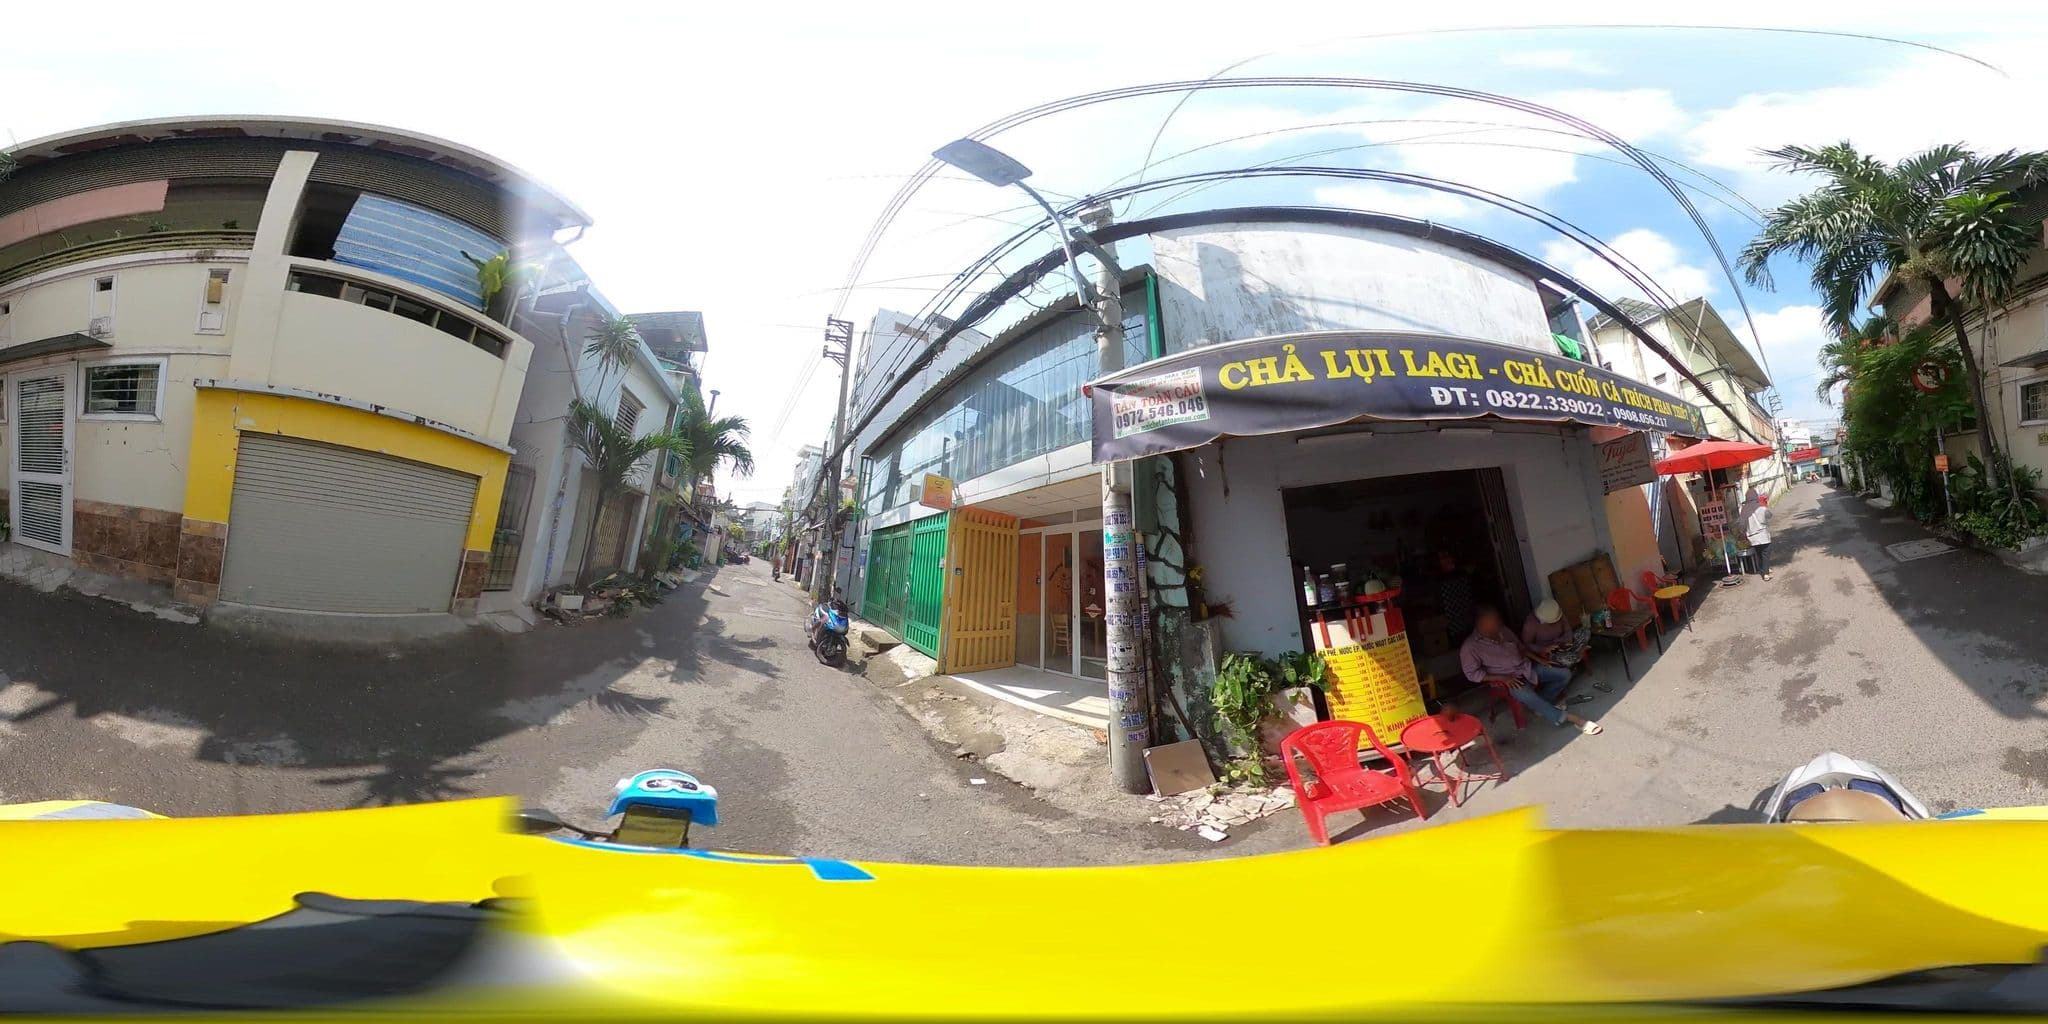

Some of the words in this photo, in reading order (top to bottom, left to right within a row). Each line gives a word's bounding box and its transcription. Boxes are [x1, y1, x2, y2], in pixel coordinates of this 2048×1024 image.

[1218, 343, 1315, 391] CHẢ
[1320, 348, 1396, 385] LỤI
[1400, 348, 1484, 380] LAGI
[1503, 357, 1555, 390] CHẢ
[1555, 367, 1601, 398] CUỐN
[1601, 380, 1623, 403] CÁ
[1621, 387, 1654, 411] TRÍCH
[1115, 396, 1205, 429] 0972.546.046
[1430, 386, 1480, 406] ĐT:
[1486, 389, 1605, 417] 0822.339022
[1613, 407, 1668, 428] 0908.056.217
